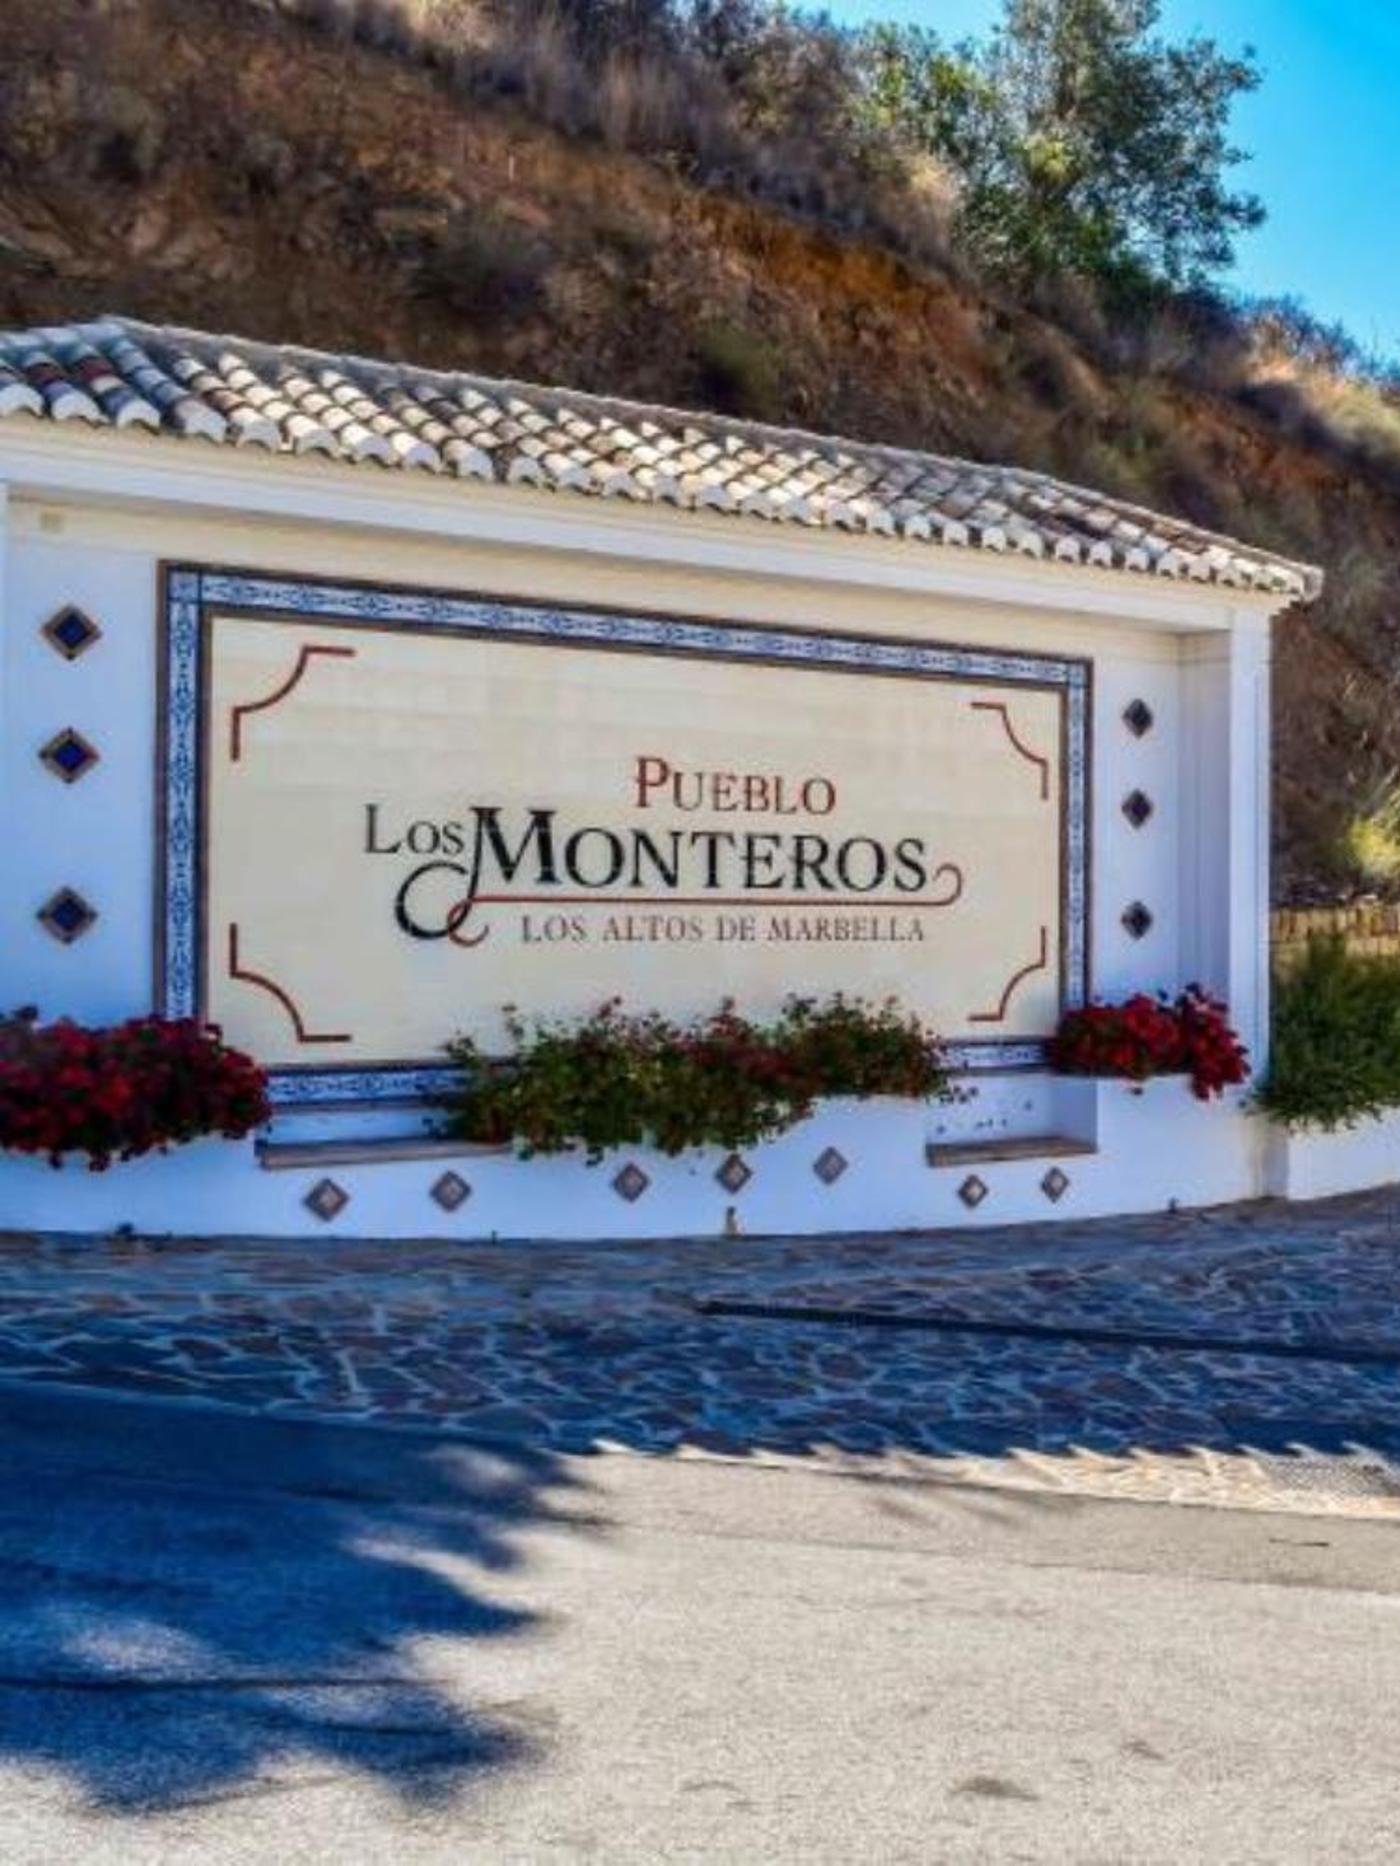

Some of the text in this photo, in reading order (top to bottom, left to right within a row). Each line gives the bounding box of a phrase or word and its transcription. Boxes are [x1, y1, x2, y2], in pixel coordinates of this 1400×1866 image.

[635, 756, 837, 816] PUEBLO
[466, 806, 928, 902] MONTEROS
[522, 914, 926, 943] LOS ALTOS DE MARBELLA
